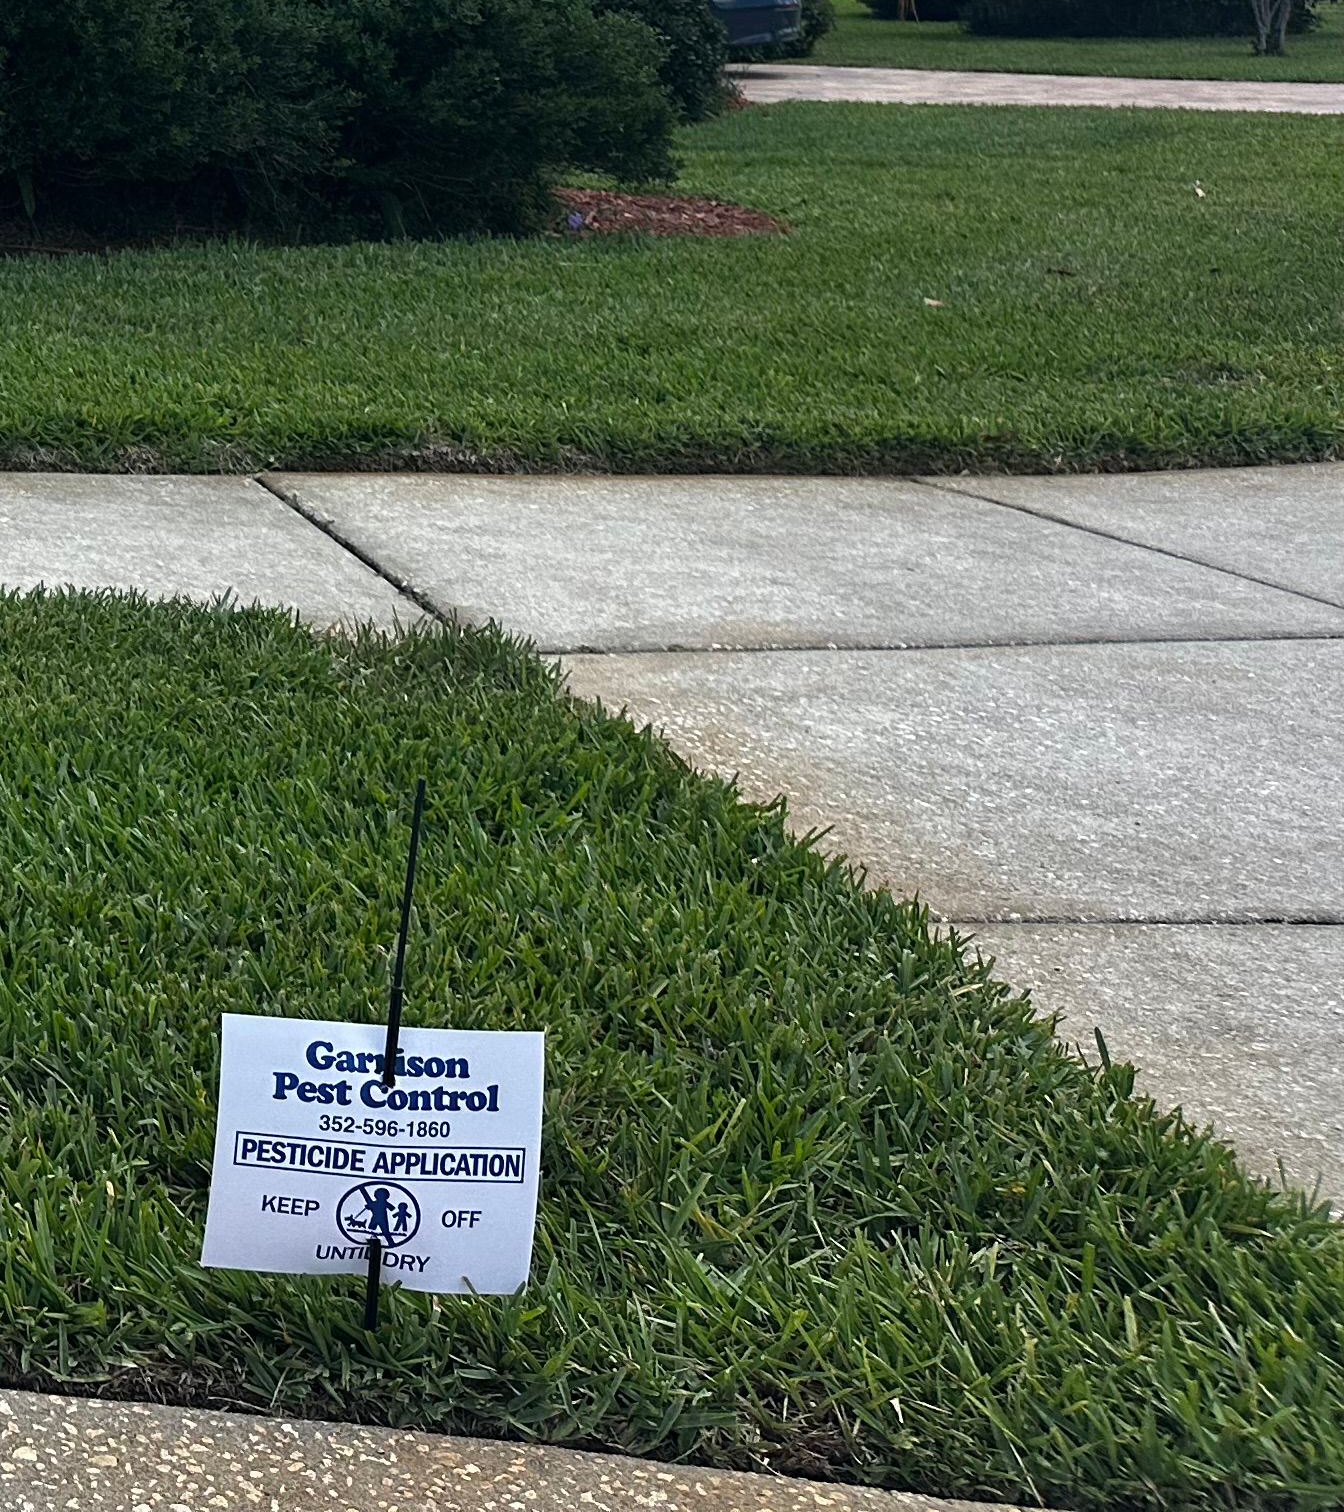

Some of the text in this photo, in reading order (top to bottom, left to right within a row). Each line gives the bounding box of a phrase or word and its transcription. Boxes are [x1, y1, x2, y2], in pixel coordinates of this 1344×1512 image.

[272, 1071, 500, 1112] Pest Control
[318, 1114, 451, 1138] 352-596-1860
[241, 1138, 521, 1178] PESTICIDE APPLICATION
[261, 1194, 482, 1229] KEEP OFF
[382, 1251, 431, 1273] DRY
